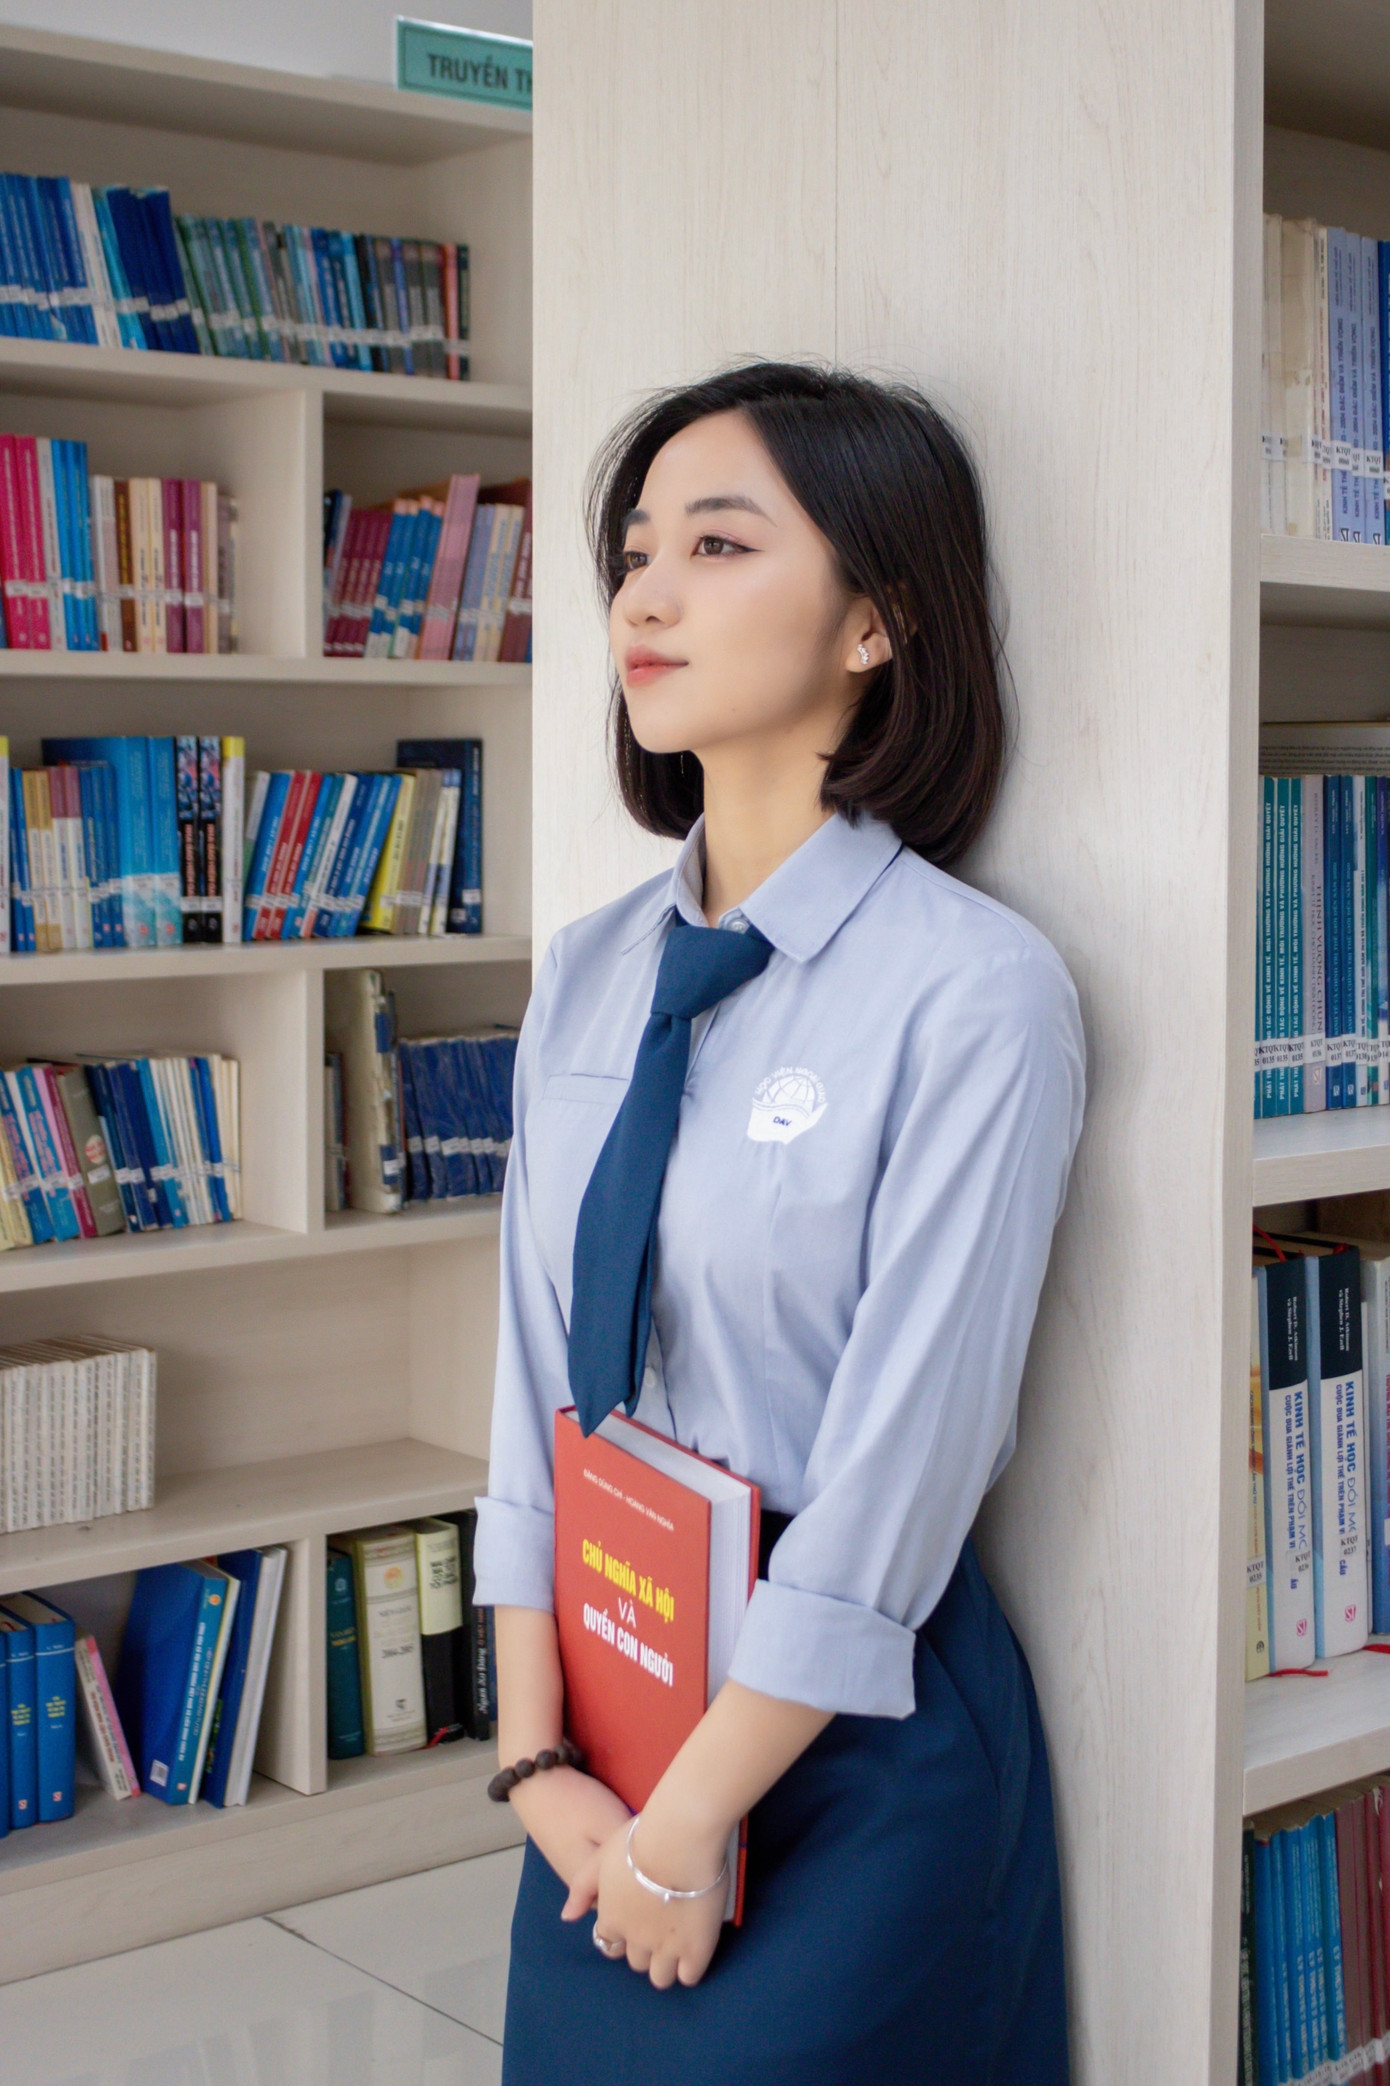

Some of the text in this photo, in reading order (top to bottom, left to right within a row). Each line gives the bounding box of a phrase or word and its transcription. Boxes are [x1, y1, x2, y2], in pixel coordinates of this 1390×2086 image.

[1327, 1042, 1341, 1051] KTQ
[1335, 1384, 1344, 1405] CUỘC
[1345, 1380, 1355, 1417] KINH
[1294, 1391, 1303, 1428] KINH
[1336, 1407, 1344, 1423] ĐUA
[1295, 1431, 1306, 1450] TẾ
[1336, 1424, 1345, 1448] GIÀNH
[1346, 1420, 1358, 1439] TẾ
[1336, 1450, 1345, 1463] LỢI
[1344, 1443, 1356, 1472] HỌC
[1284, 1394, 1296, 1549] CUỘC ĐUA GIÀNH LỢI THẾ TRÊN PHẠM VI
[1293, 1454, 1305, 1484] HỌC
[1337, 1465, 1346, 1479] THẾ
[1337, 1481, 1346, 1501] TRÊN
[1337, 1503, 1345, 1526] PHẠM
[1246, 1561, 1264, 1574] KTQT
[582, 1539, 675, 1623] CHỦ NGHĨA XÃ HỘI
[617, 1597, 637, 1629] VÀ
[616, 1629, 638, 1661] CON
[640, 1642, 674, 1687] NGƯỜI
